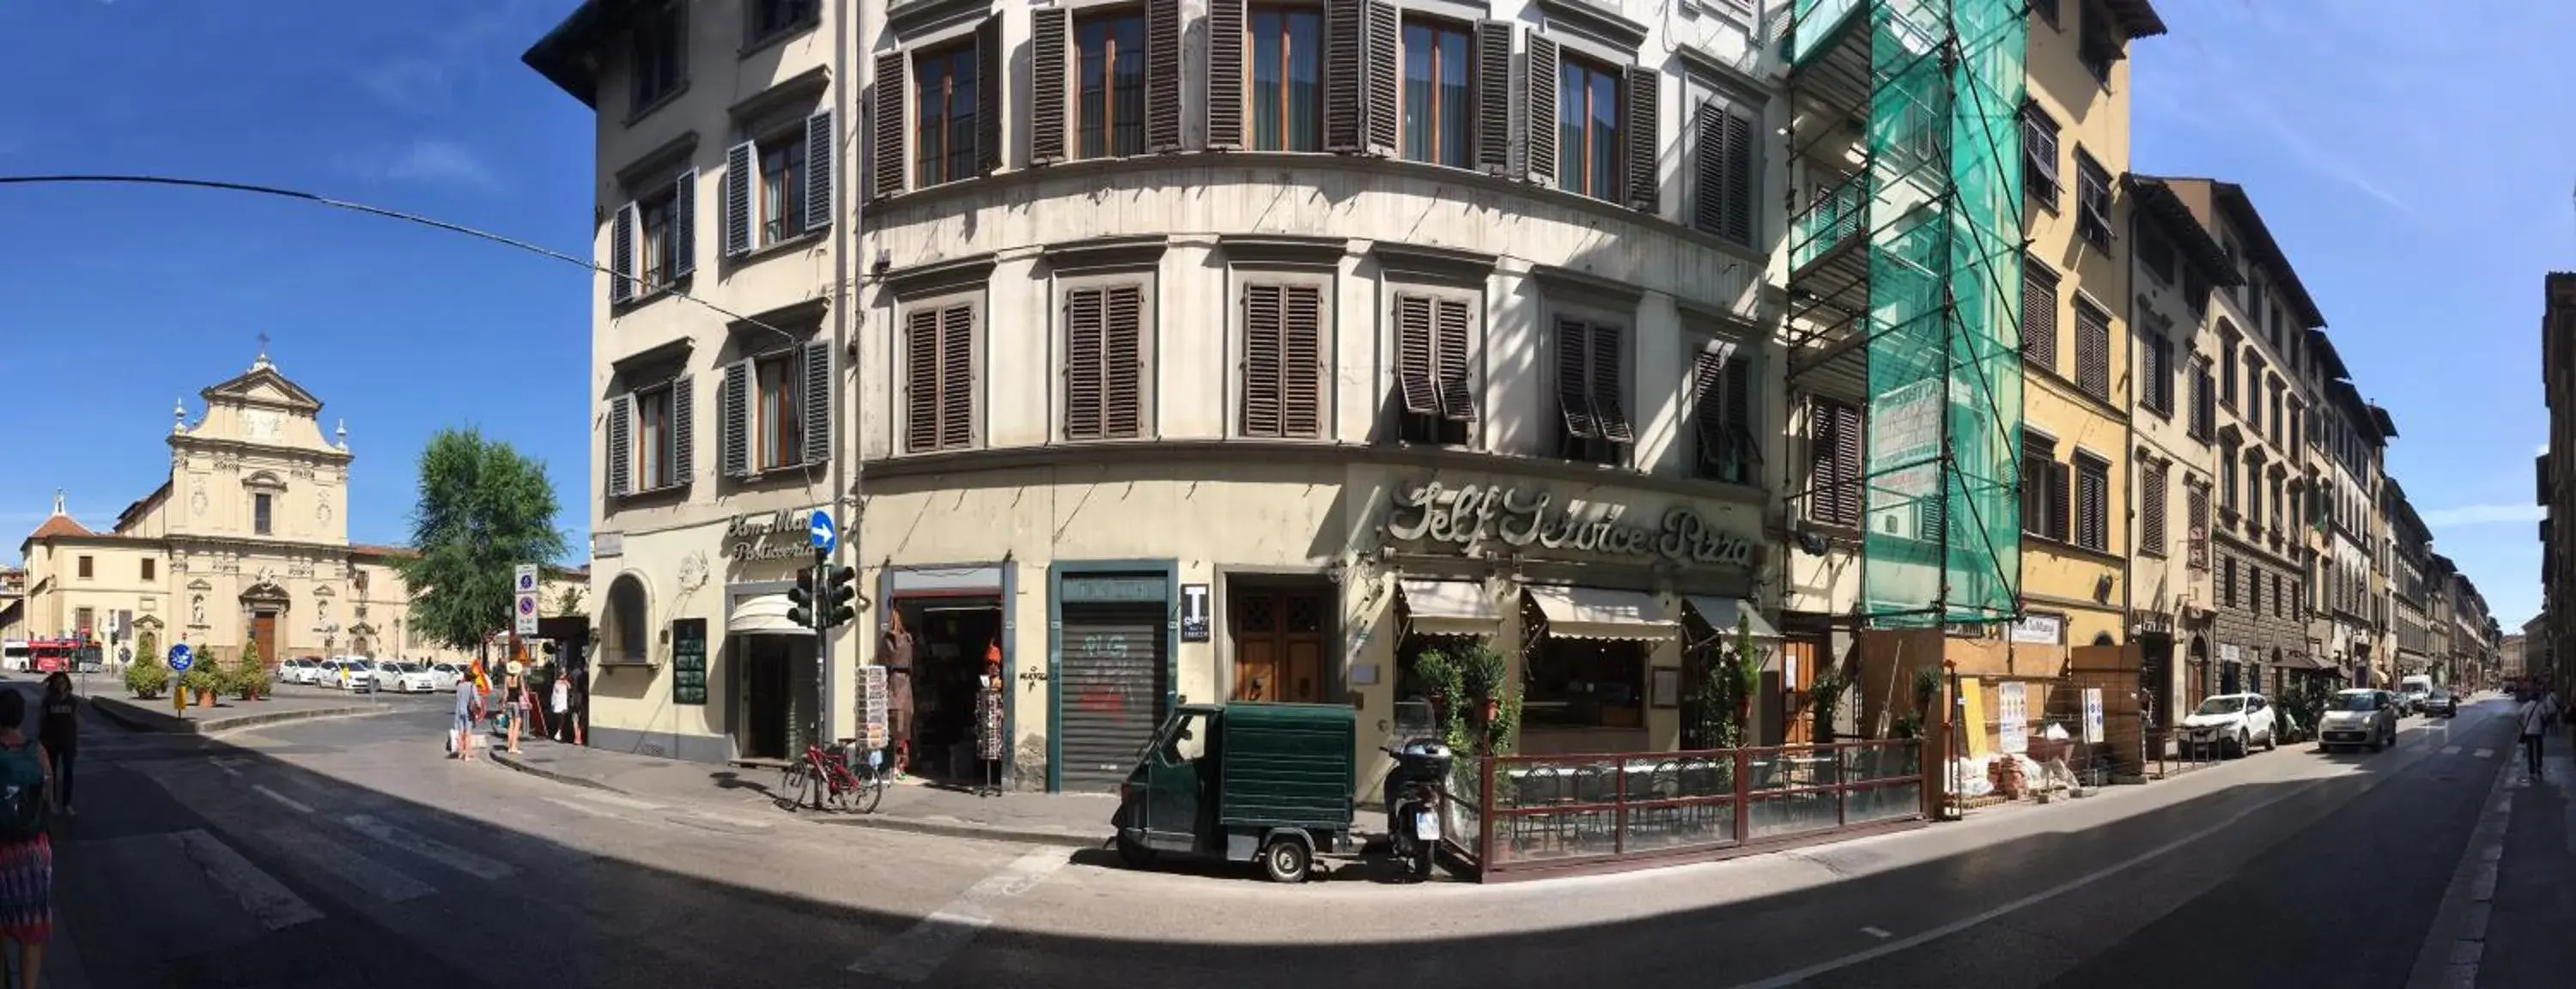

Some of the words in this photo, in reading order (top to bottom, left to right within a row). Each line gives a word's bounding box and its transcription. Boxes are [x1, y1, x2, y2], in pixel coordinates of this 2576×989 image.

[1388, 480, 1499, 555] Self
[1500, 485, 1646, 549] Service
[1660, 507, 1753, 566] Pizza
